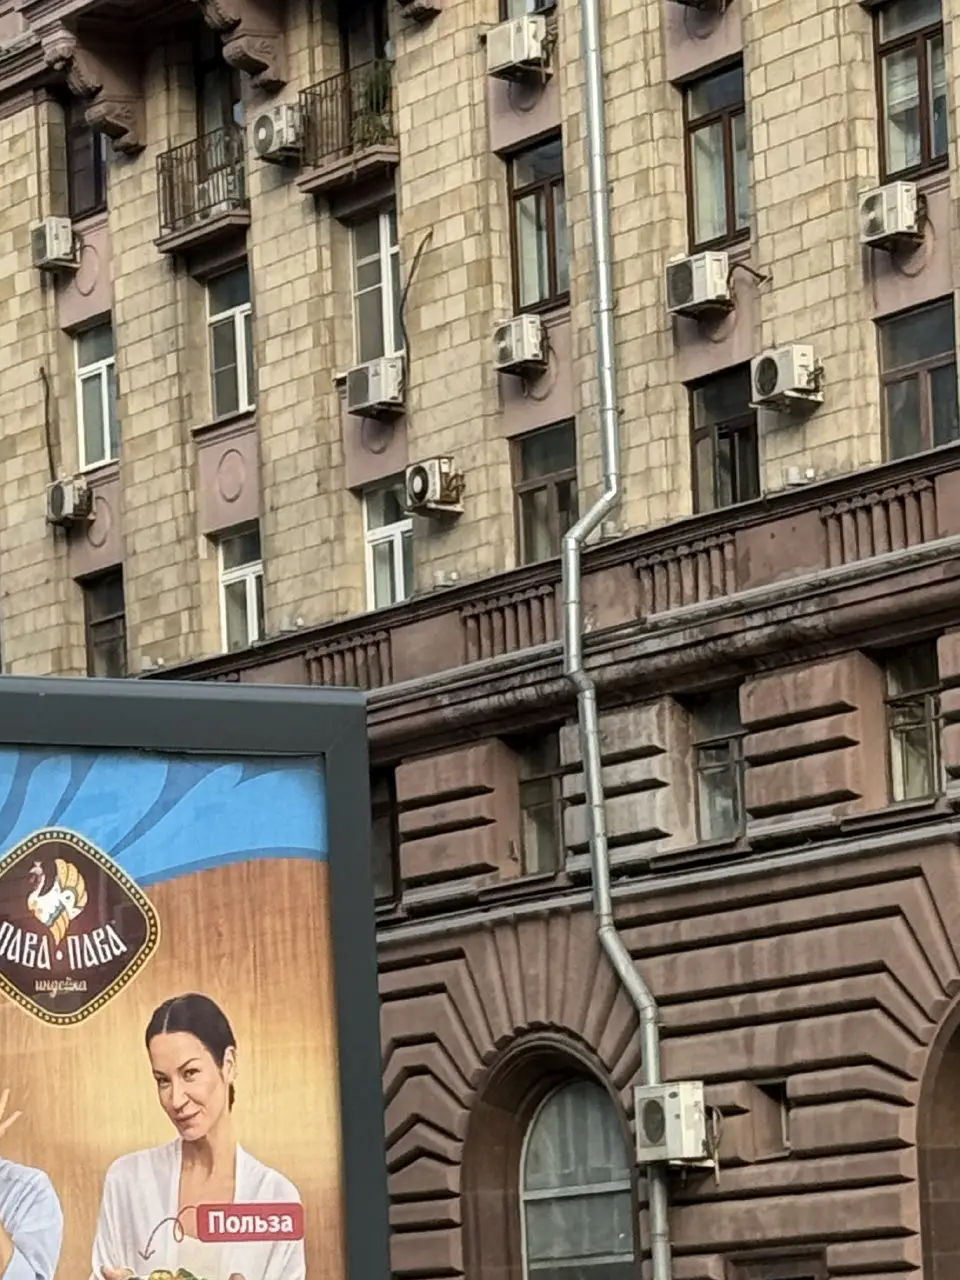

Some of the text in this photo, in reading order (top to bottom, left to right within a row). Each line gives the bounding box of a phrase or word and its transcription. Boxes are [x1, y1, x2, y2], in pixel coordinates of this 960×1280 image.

[67, 924, 128, 970] ПАВА
[35, 976, 87, 998] индейка
[208, 1211, 293, 1234] Польза
